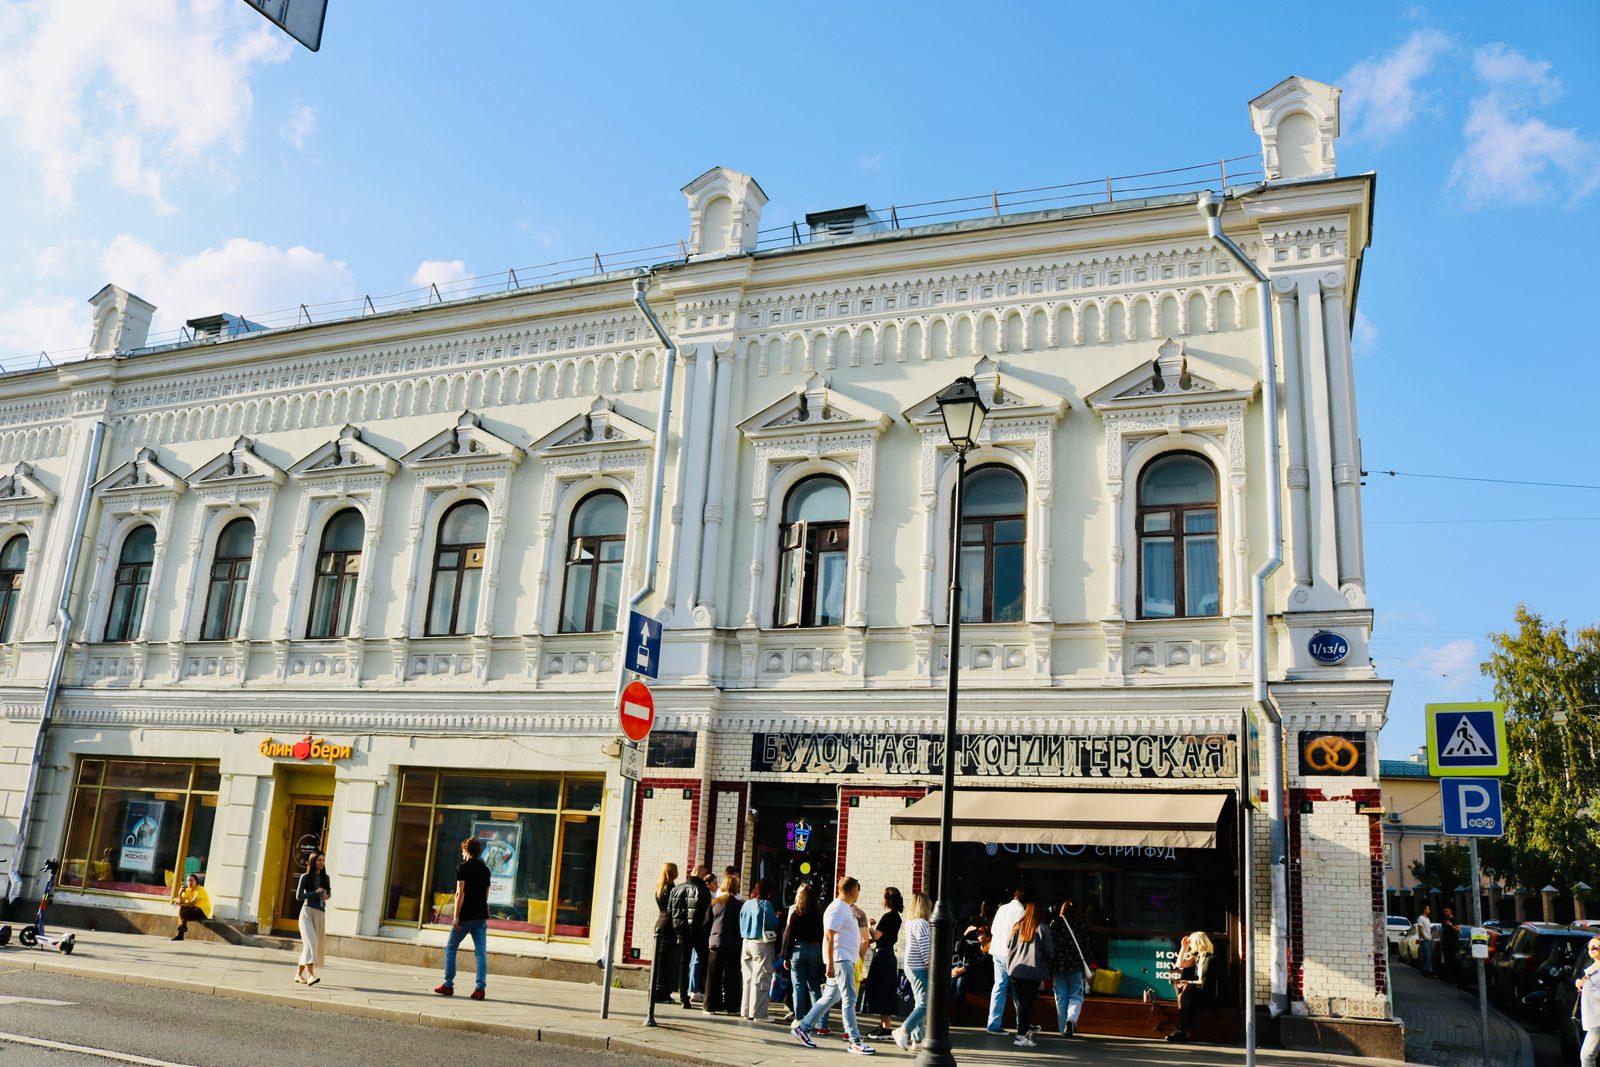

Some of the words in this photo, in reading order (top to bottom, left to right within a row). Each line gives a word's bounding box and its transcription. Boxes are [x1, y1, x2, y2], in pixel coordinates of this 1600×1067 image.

[1311, 642, 1346, 655] 1/13/6
[259, 737, 294, 756] блин
[310, 738, 352, 763] бери
[763, 733, 922, 767] БУЛОЧНАЯ
[962, 734, 1225, 768] КОНДИТЕРСКАЯ
[1485, 819, 1494, 827] 20
[1155, 951, 1165, 959] И
